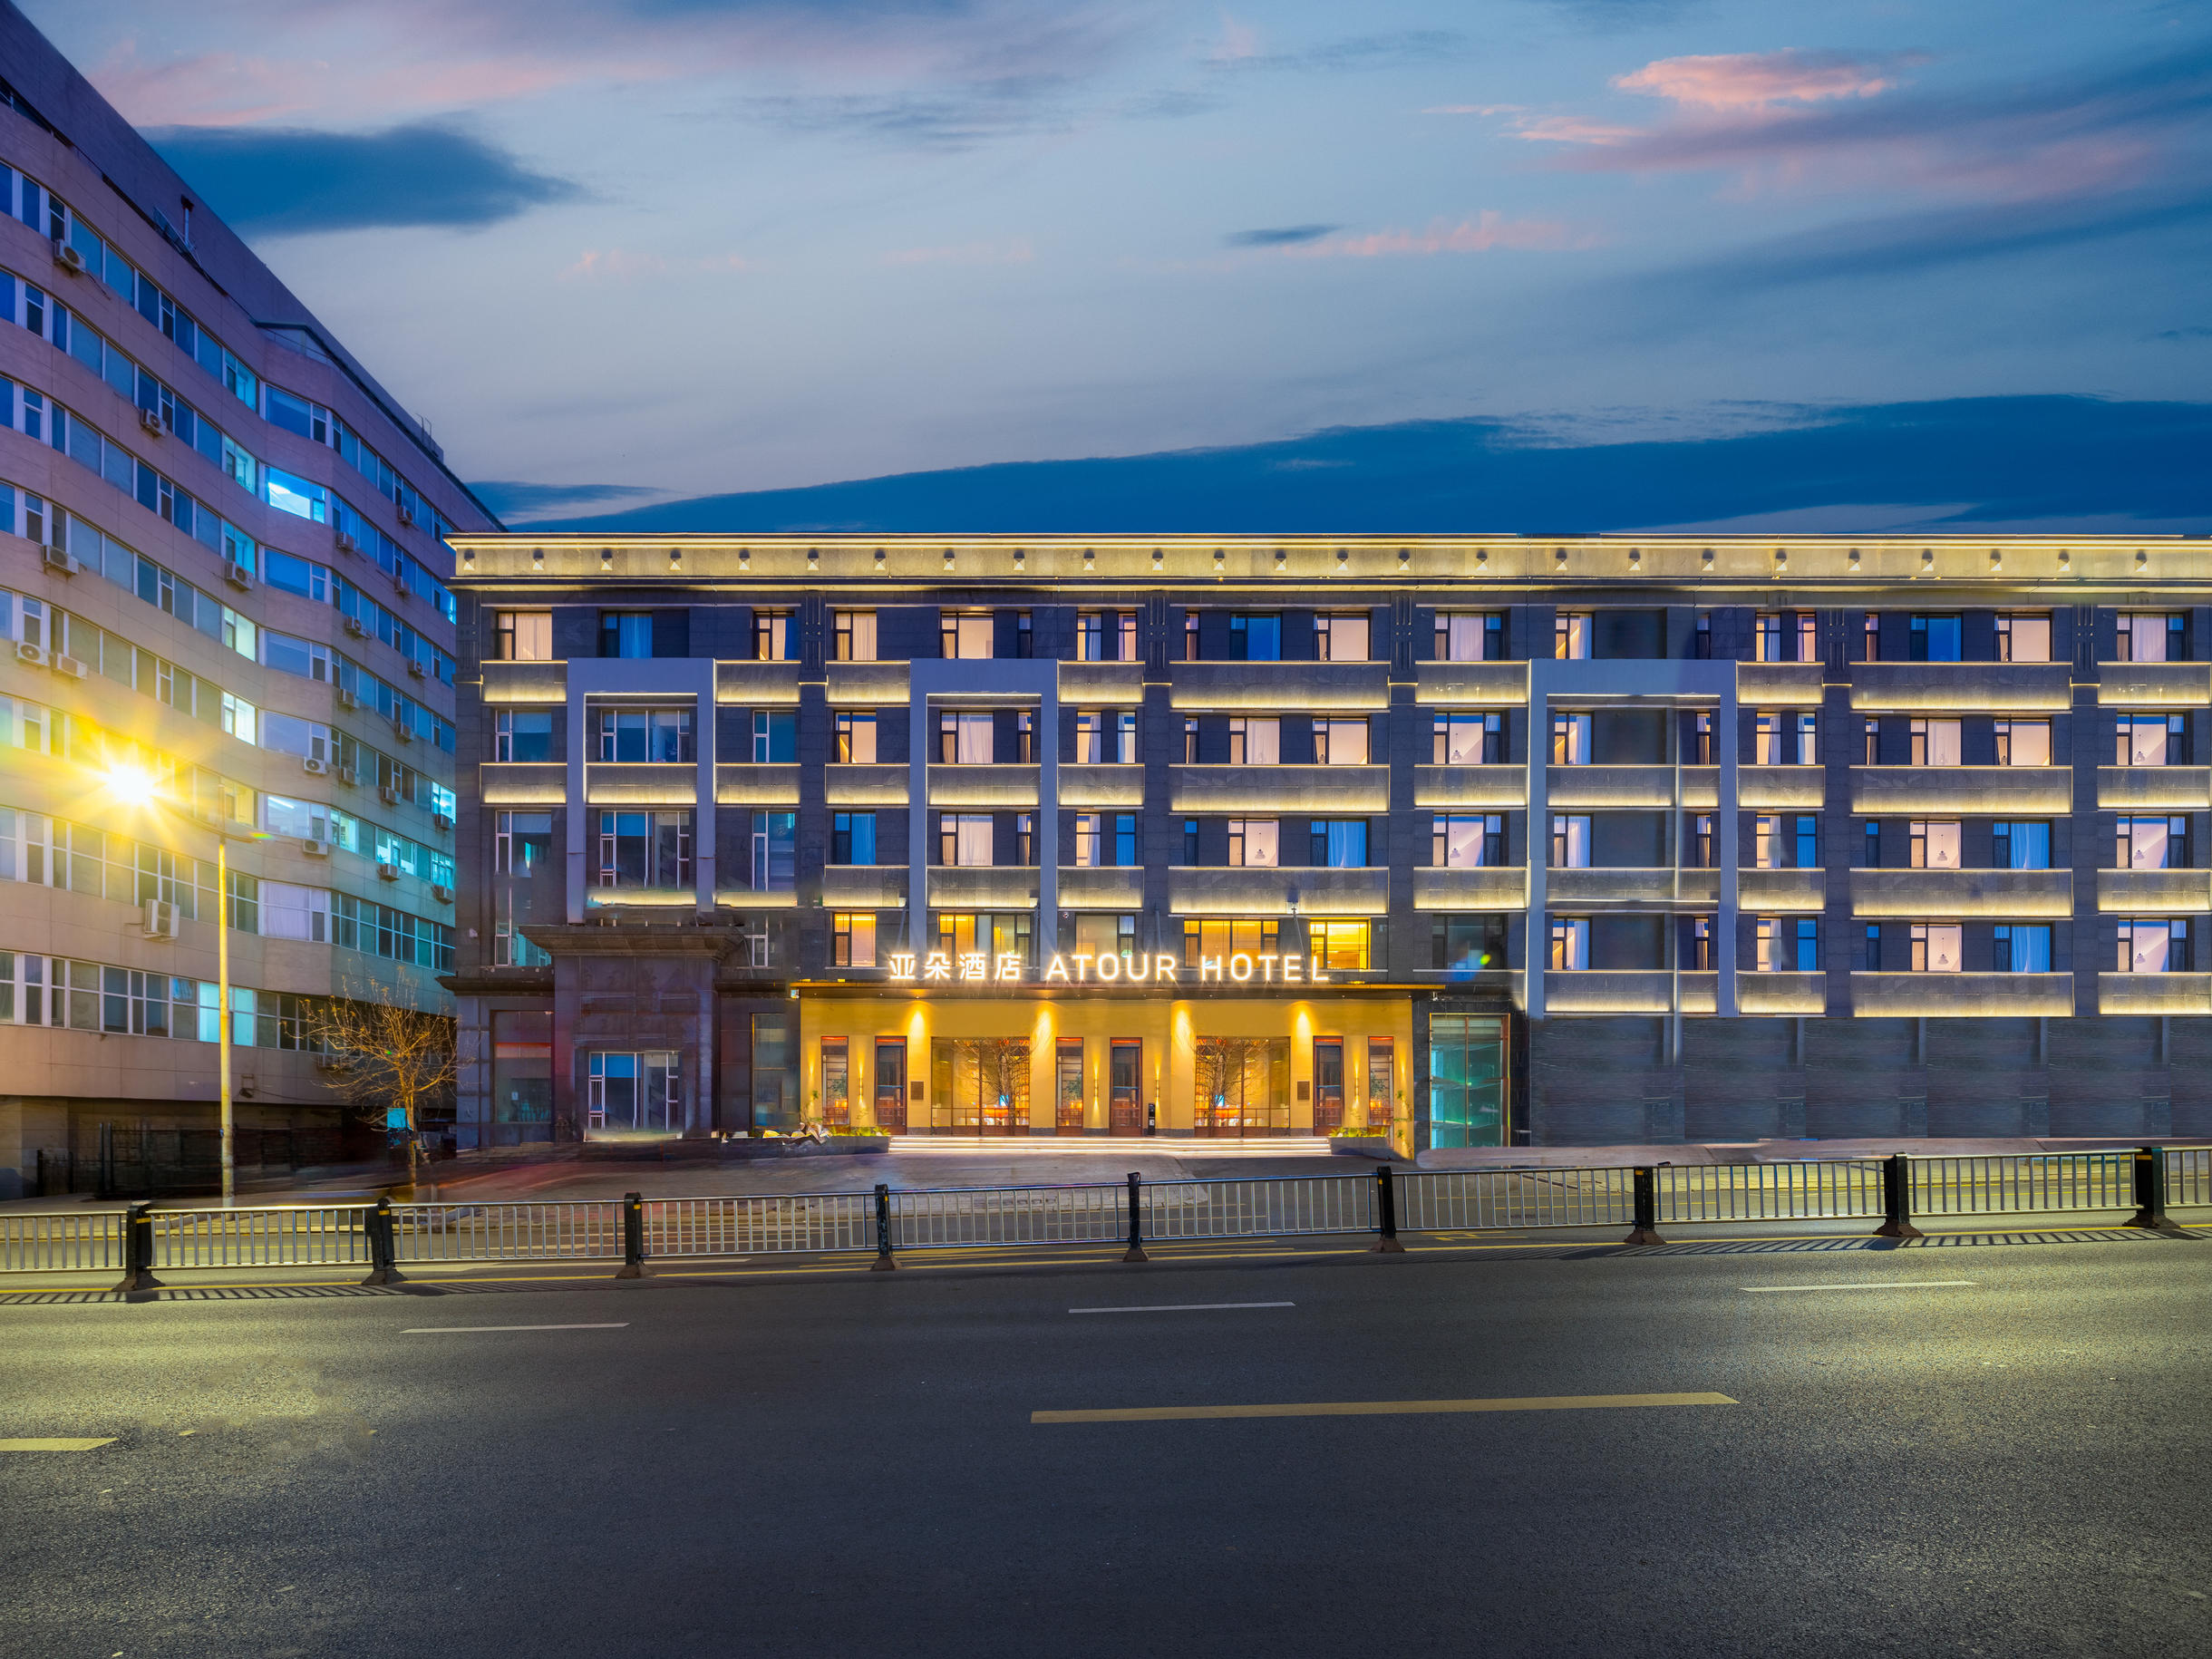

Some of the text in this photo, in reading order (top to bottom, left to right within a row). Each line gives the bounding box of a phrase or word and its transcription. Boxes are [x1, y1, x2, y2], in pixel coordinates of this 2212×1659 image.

[889, 952, 1022, 981] 亚朵酒店
[1047, 955, 1329, 981] ATOUR HOTEL
